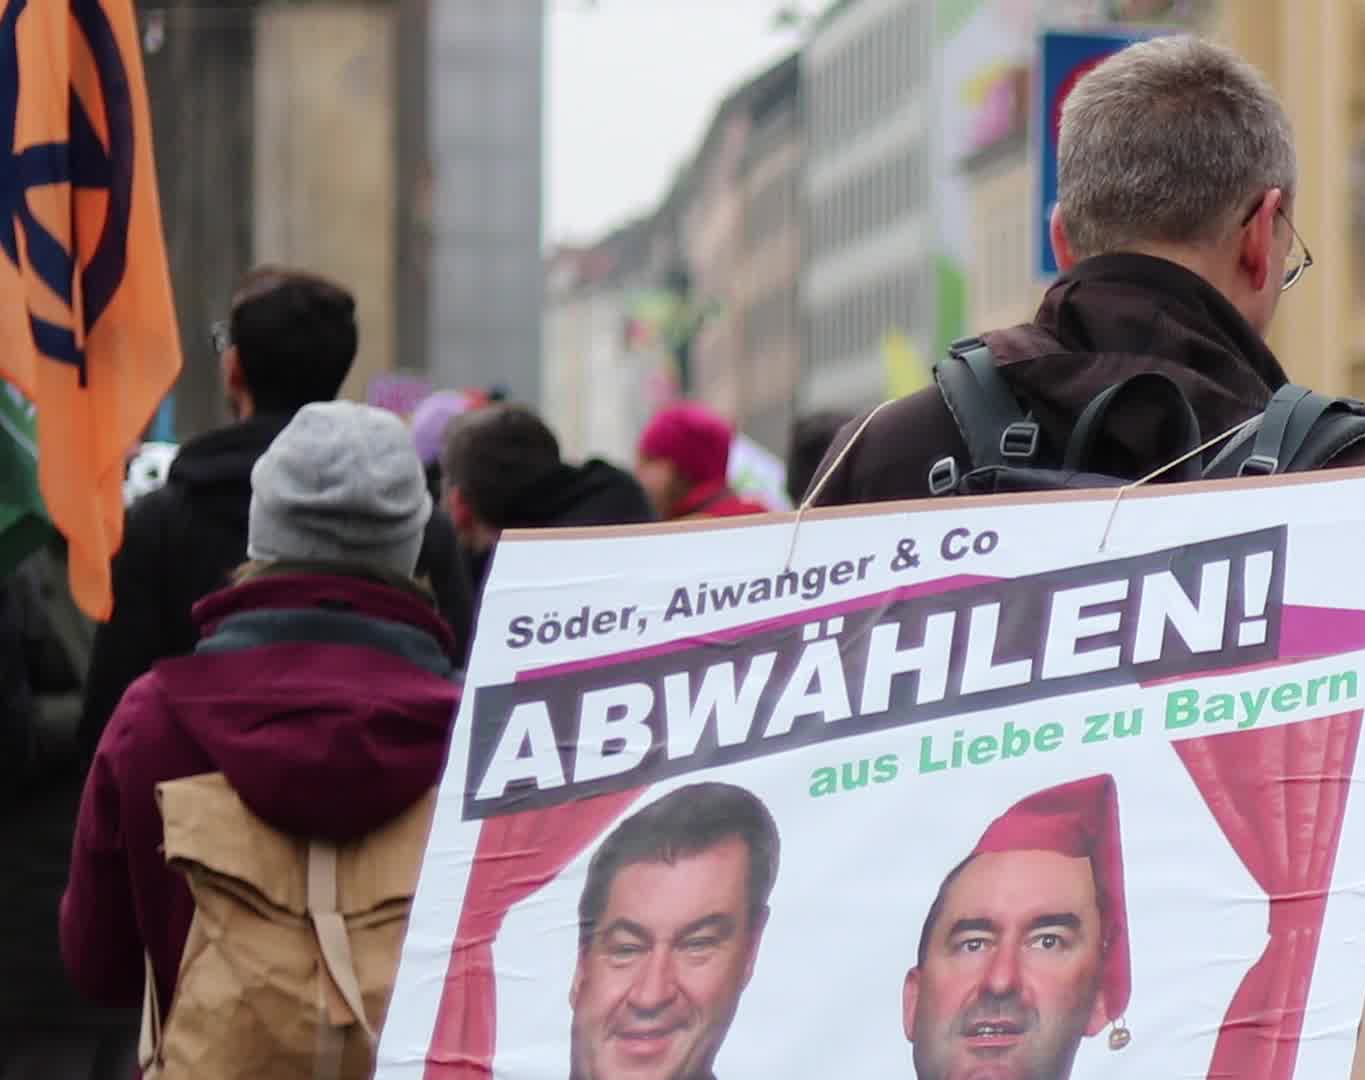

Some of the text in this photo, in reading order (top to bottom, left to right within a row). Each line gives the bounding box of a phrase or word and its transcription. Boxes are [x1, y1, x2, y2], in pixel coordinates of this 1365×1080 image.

[507, 525, 998, 652] Söder, Aiwanger & Co
[471, 549, 1275, 801] ABWÄHLEN!
[809, 665, 1358, 798] aus Liebe zu Bayern
